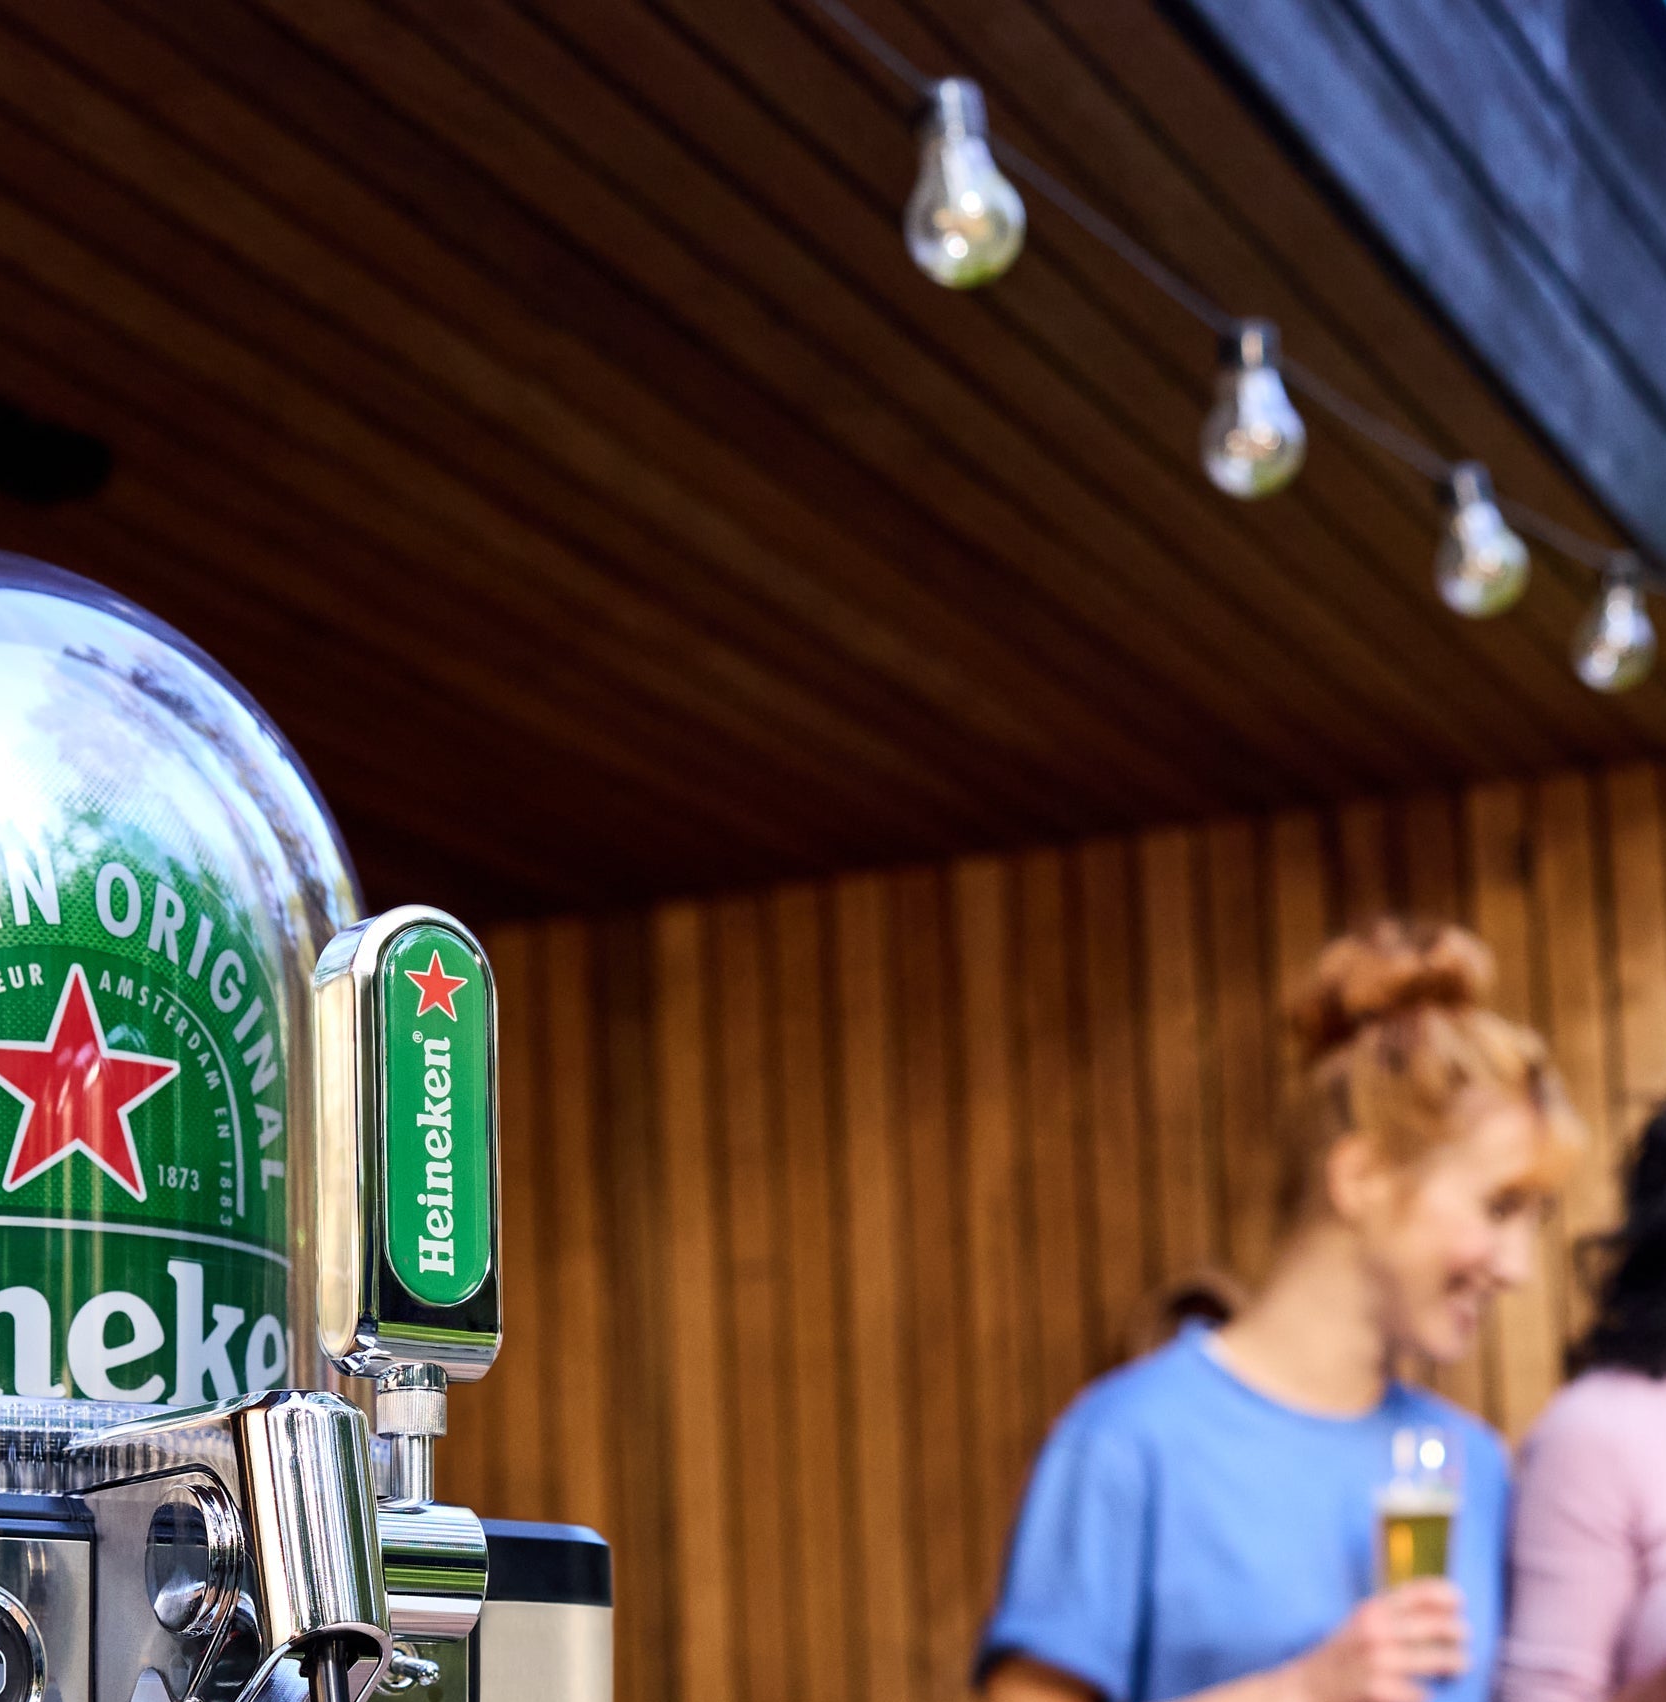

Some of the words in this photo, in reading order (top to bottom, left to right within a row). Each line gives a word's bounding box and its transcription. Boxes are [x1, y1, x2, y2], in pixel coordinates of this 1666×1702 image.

[95, 861, 285, 1191] ORIGINAL
[98, 969, 222, 1091] AMSTERDAM
[214, 1106, 231, 1139] EN
[157, 1163, 201, 1192] 1873
[219, 1161, 234, 1227] 1883
